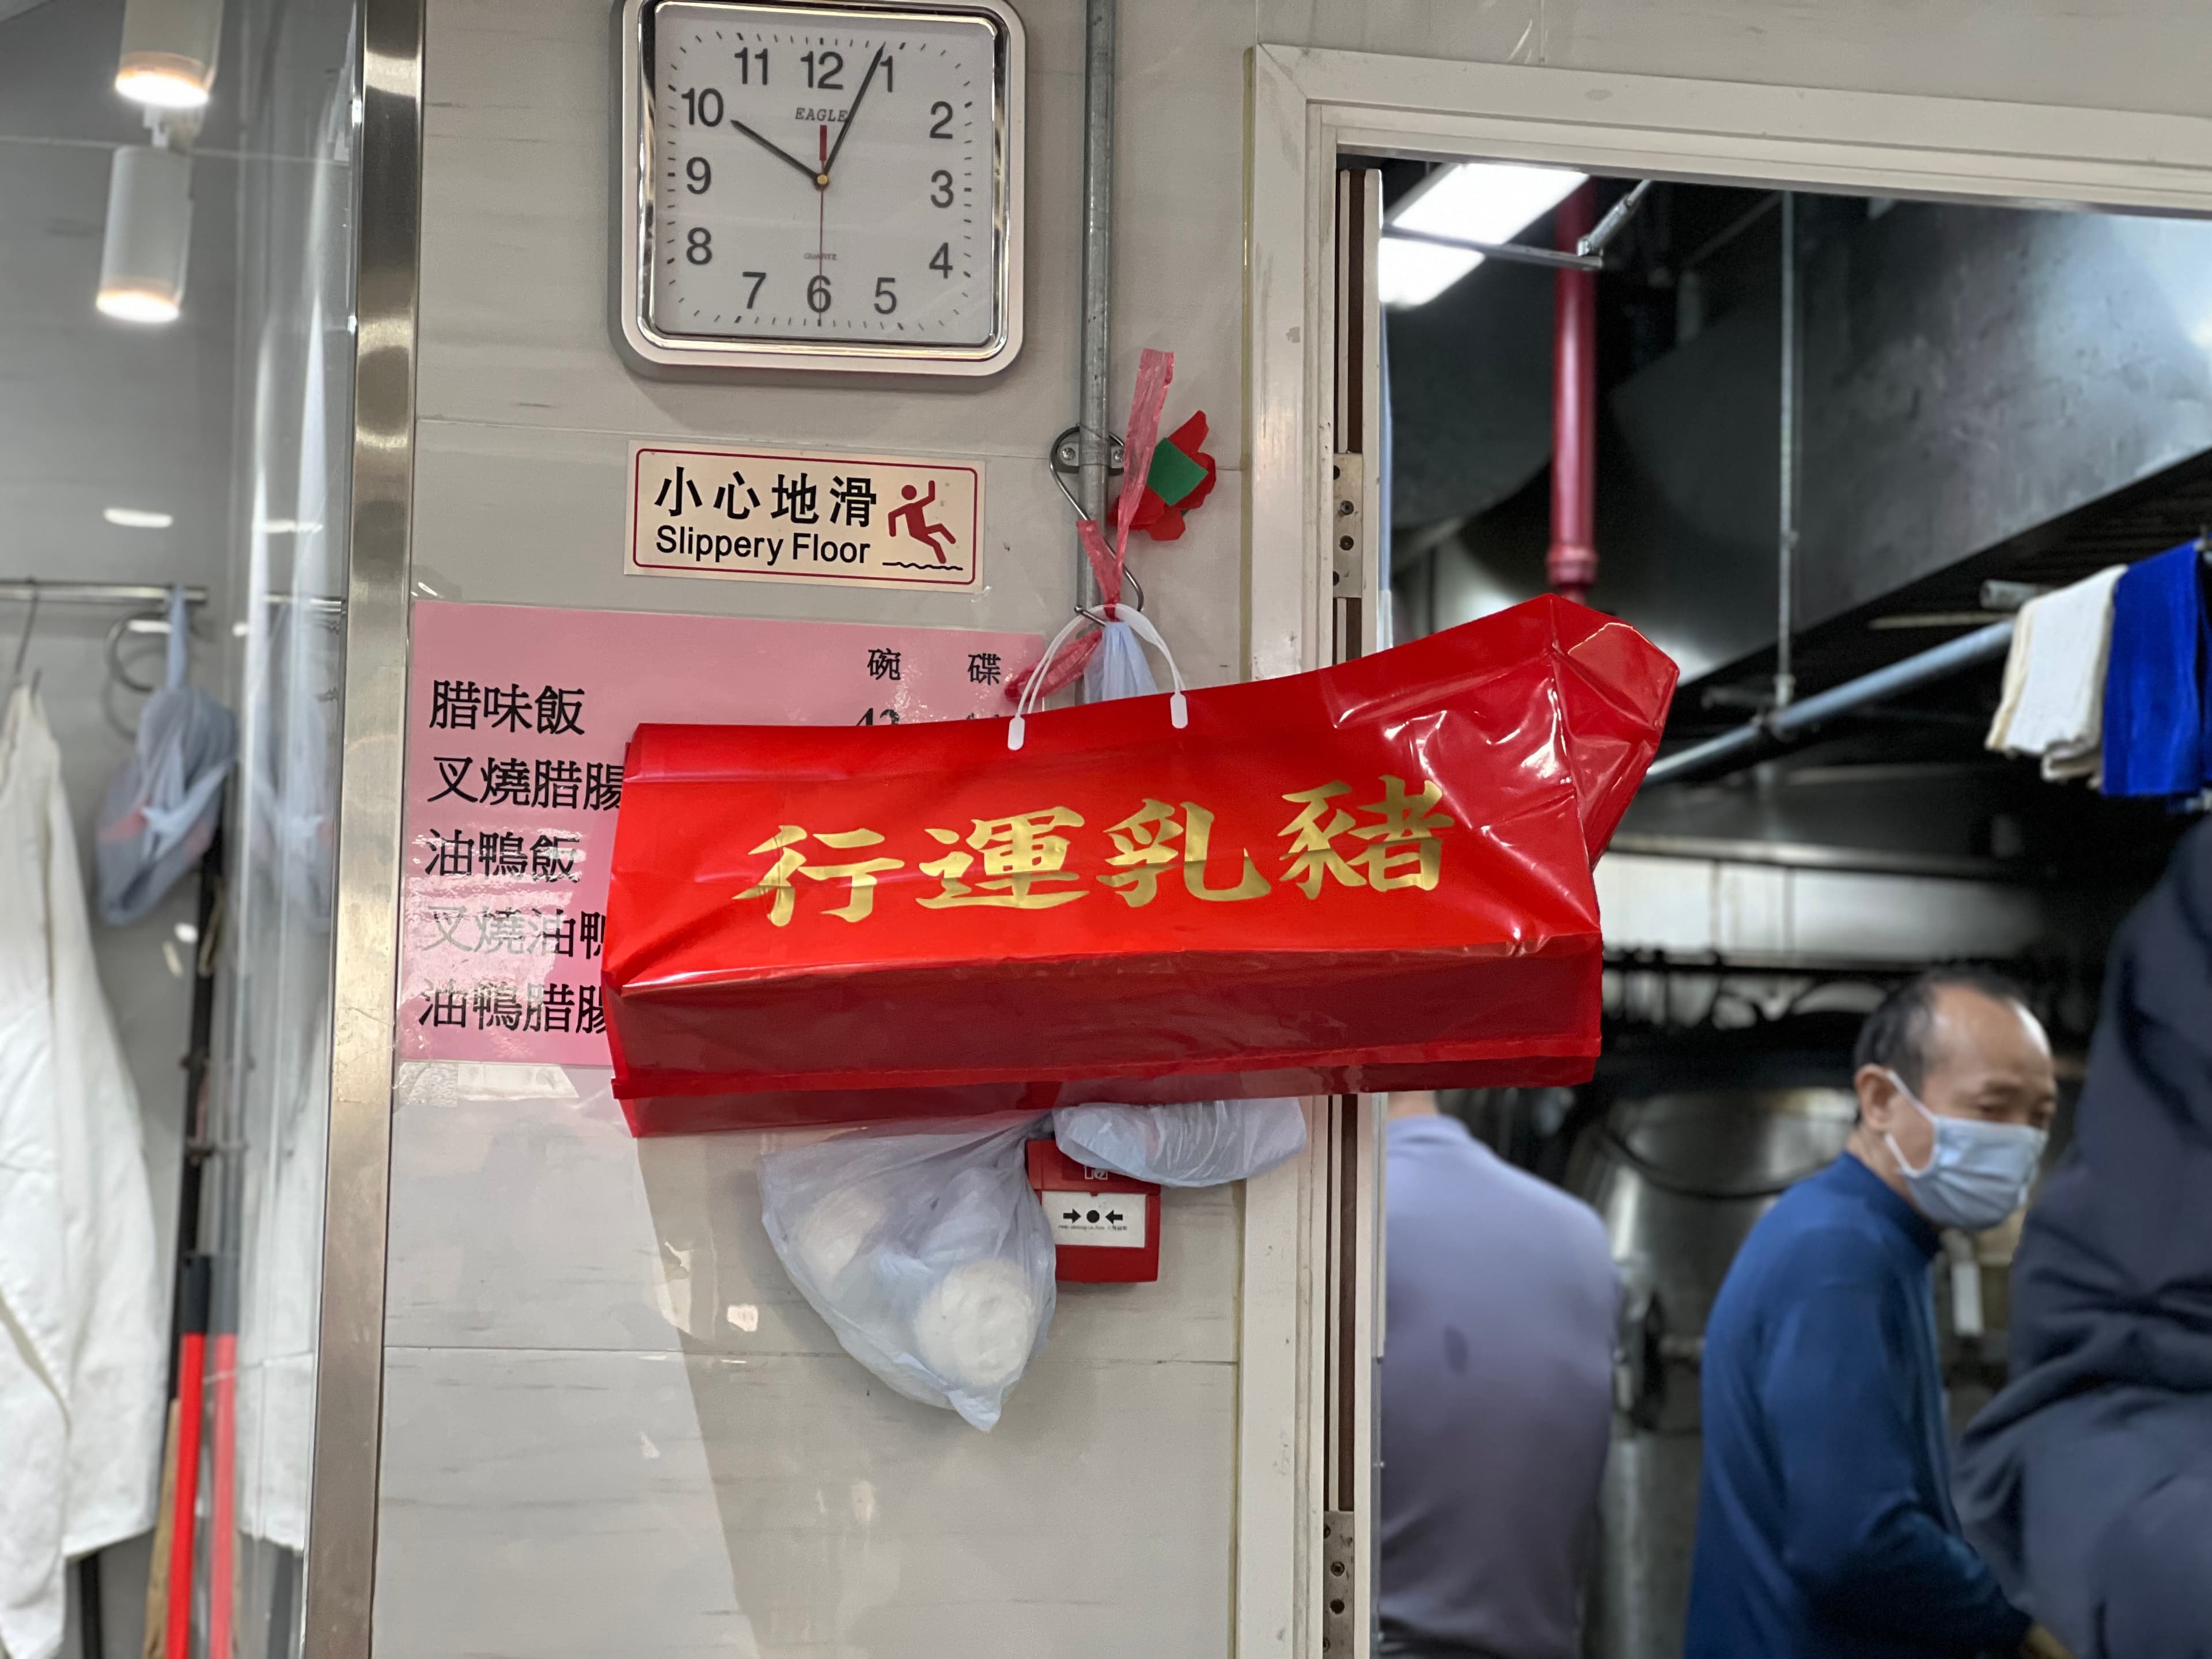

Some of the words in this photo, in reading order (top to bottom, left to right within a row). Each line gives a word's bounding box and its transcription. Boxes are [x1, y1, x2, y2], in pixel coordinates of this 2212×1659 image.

[734, 47, 768, 85] 11
[800, 51, 843, 90] 12
[880, 55, 893, 93] 1
[681, 88, 724, 127] 10
[795, 107, 849, 123] EAGLE
[929, 101, 953, 139] 2
[686, 157, 711, 195] 9
[930, 170, 954, 209] 3
[686, 227, 713, 266] 8
[929, 242, 953, 279] 4
[742, 271, 767, 309] 7
[806, 275, 831, 313] 6
[873, 277, 897, 315] 5
[654, 466, 877, 527] 小心地滑
[656, 525, 783, 566] Slippery
[793, 532, 871, 564] Floor
[867, 647, 902, 680] 碗
[967, 653, 1001, 685] 碟
[429, 680, 585, 736] 腊味飯
[425, 828, 580, 883] 油鴨飯
[733, 775, 1455, 927] 行運乳豬
